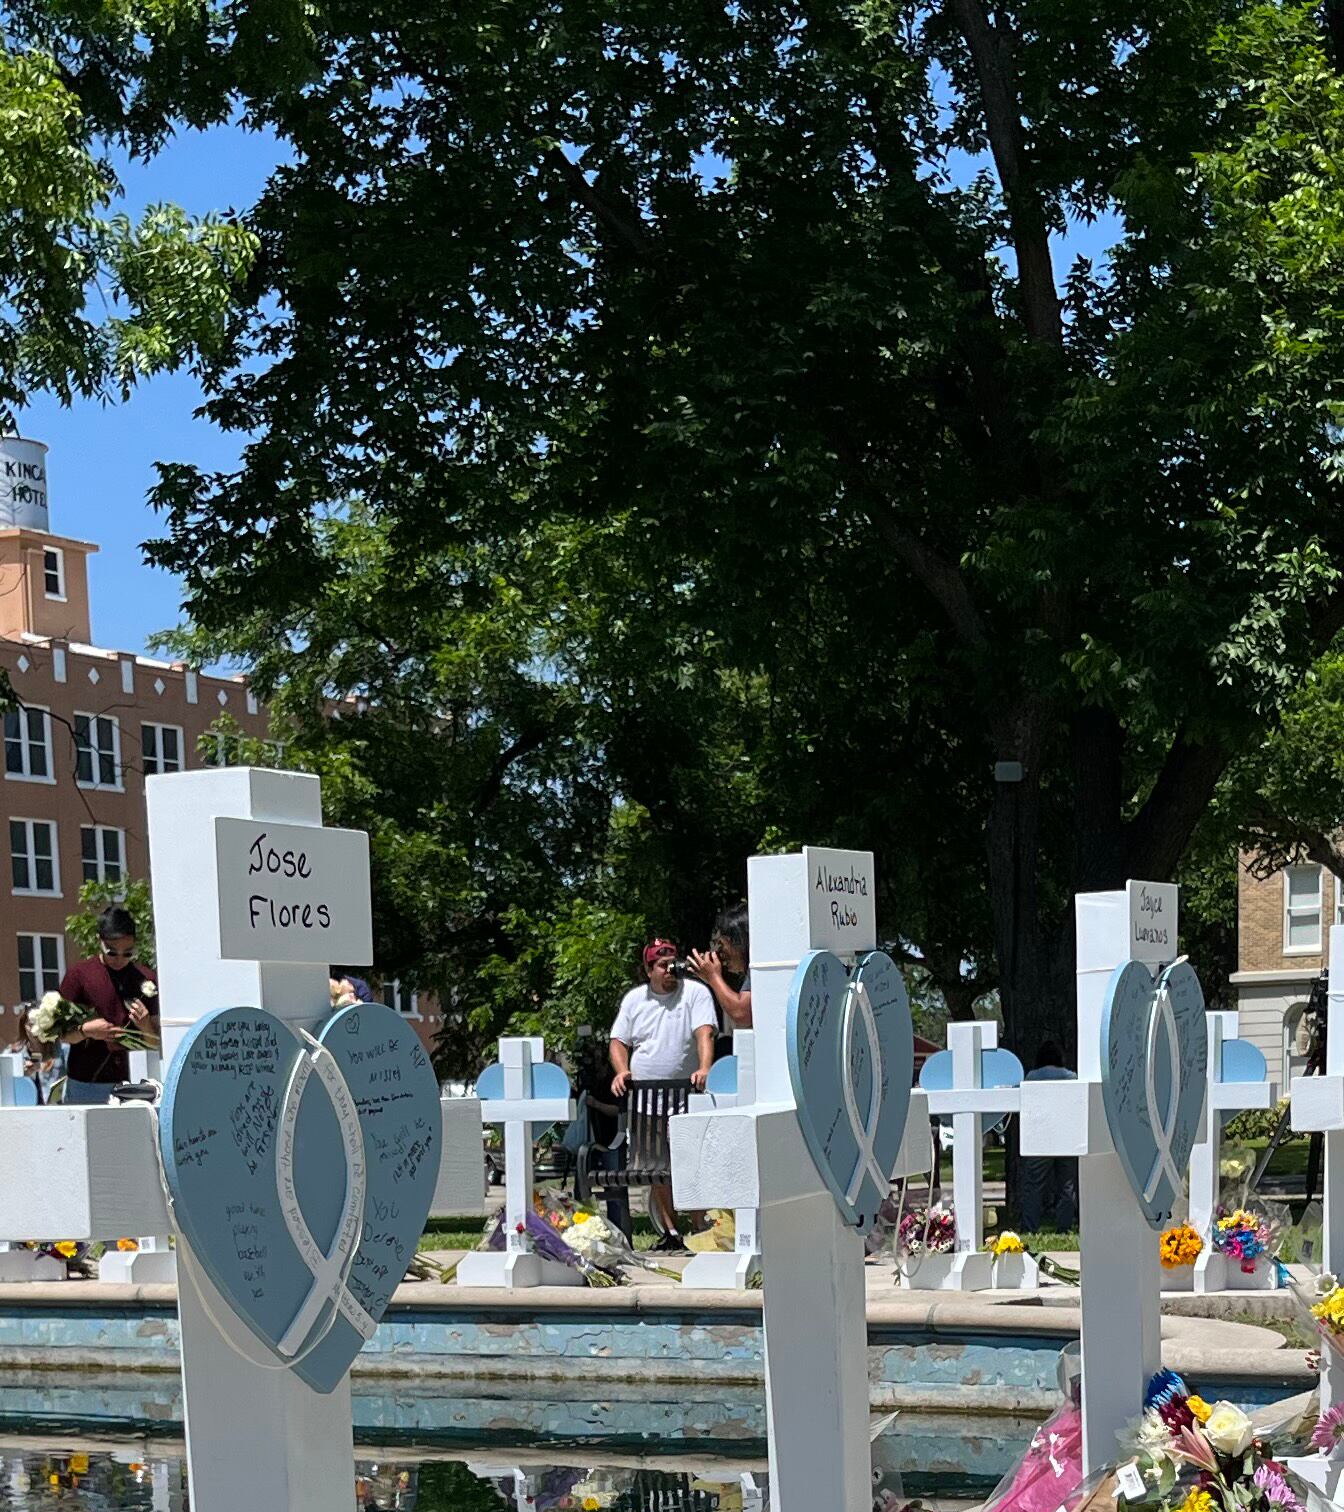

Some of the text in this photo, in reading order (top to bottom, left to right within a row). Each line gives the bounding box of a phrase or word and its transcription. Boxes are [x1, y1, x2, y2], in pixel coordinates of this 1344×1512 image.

[249, 833, 312, 879] Jose
[815, 865, 868, 896] Alexandria
[249, 895, 331, 929] Flores
[830, 900, 858, 930] Rubio
